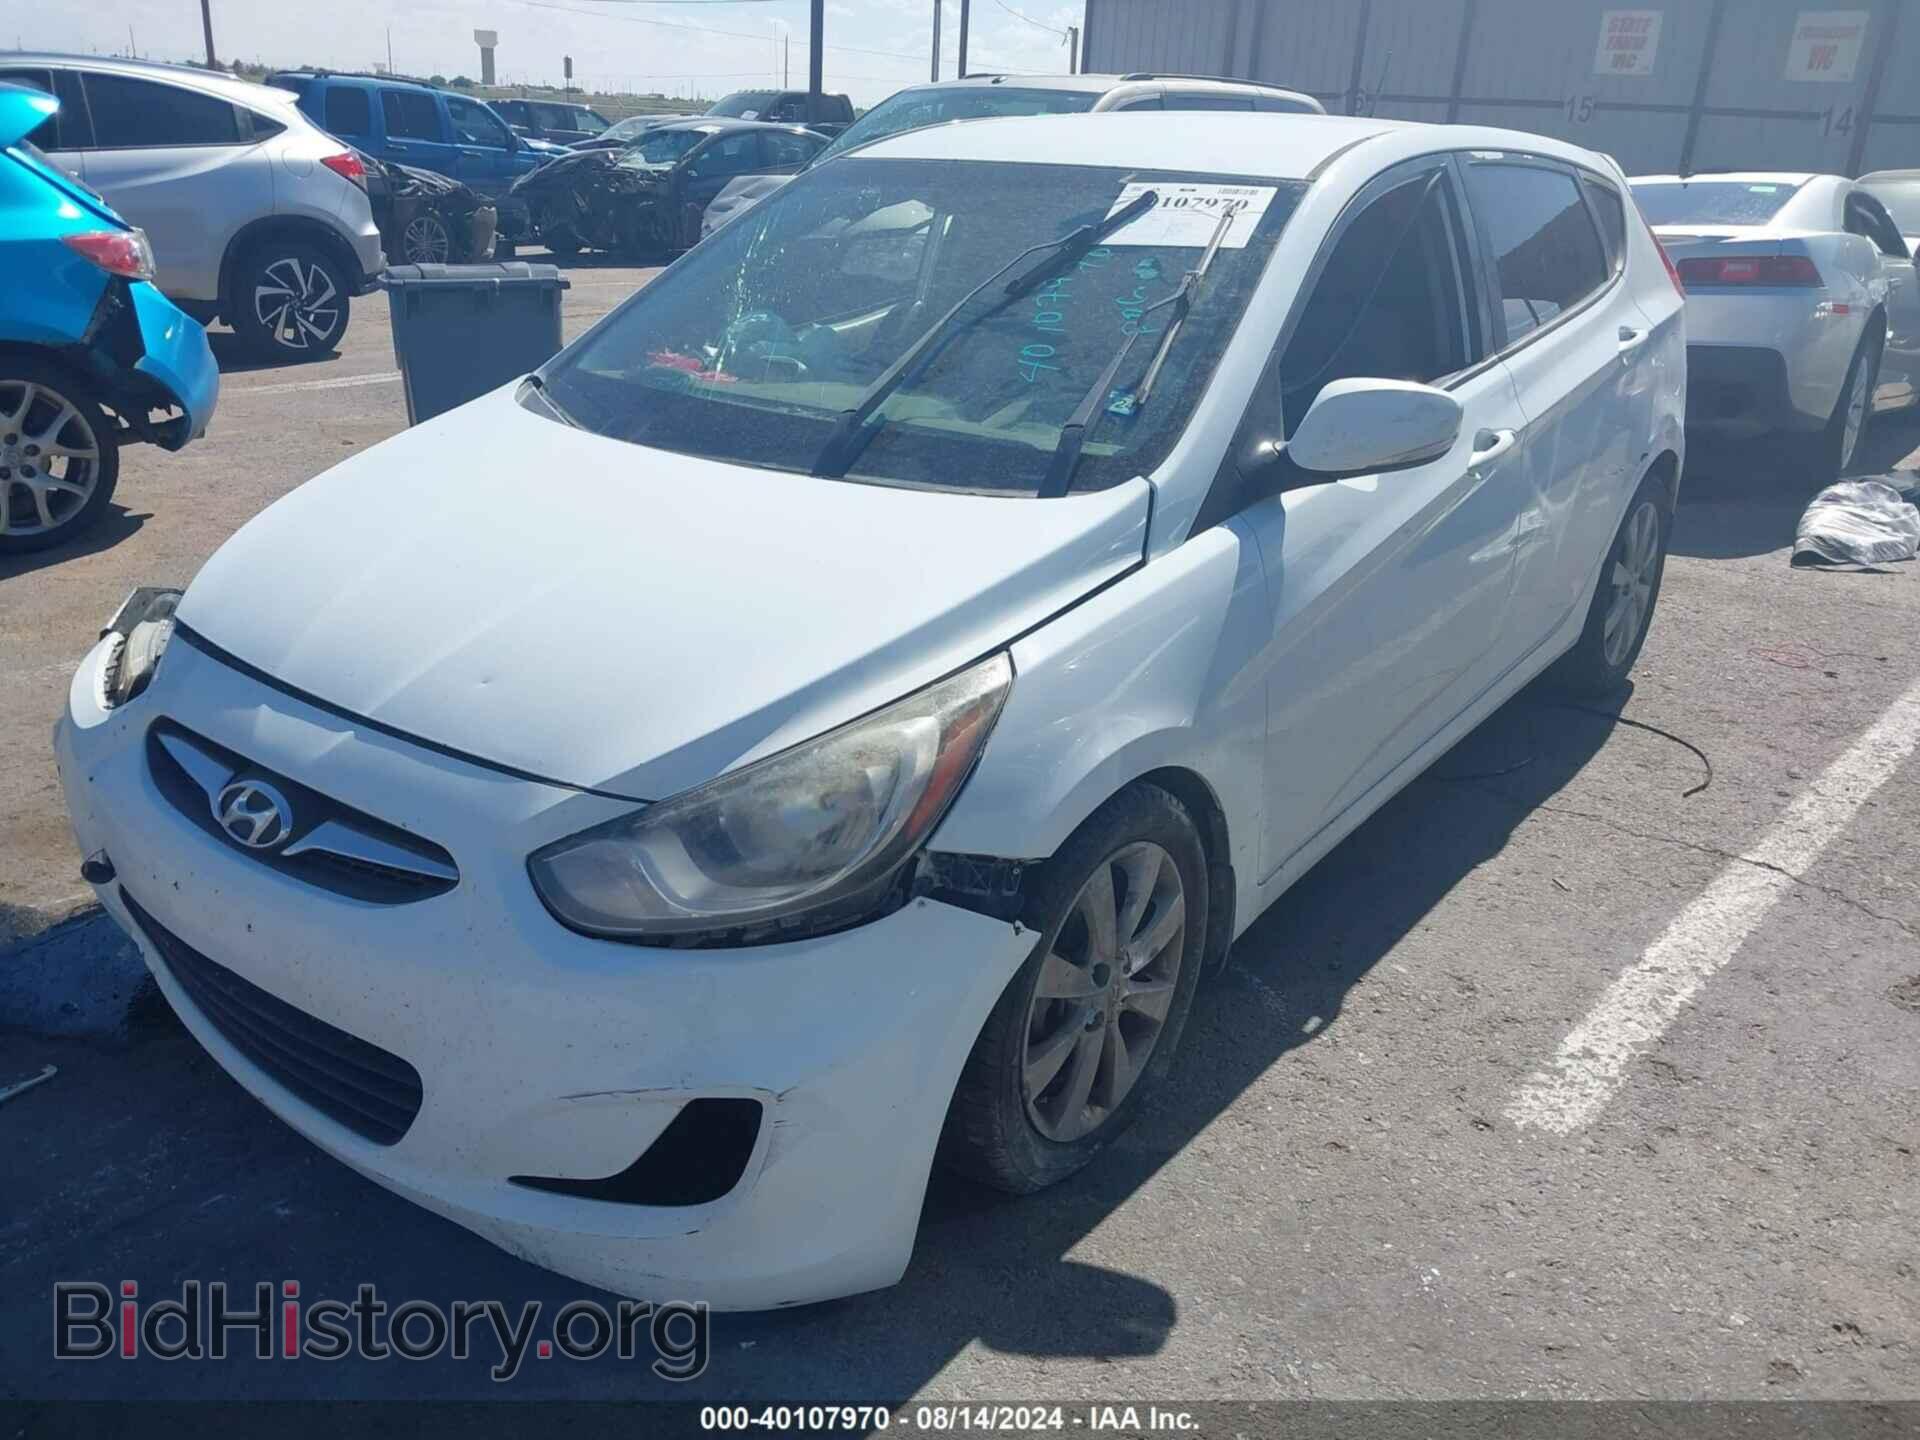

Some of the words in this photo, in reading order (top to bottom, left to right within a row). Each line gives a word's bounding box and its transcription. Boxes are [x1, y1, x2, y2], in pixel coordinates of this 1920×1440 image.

[1566, 96, 1593, 123] 15
[1821, 105, 1852, 137] 14
[1160, 196, 1249, 211] 107970
